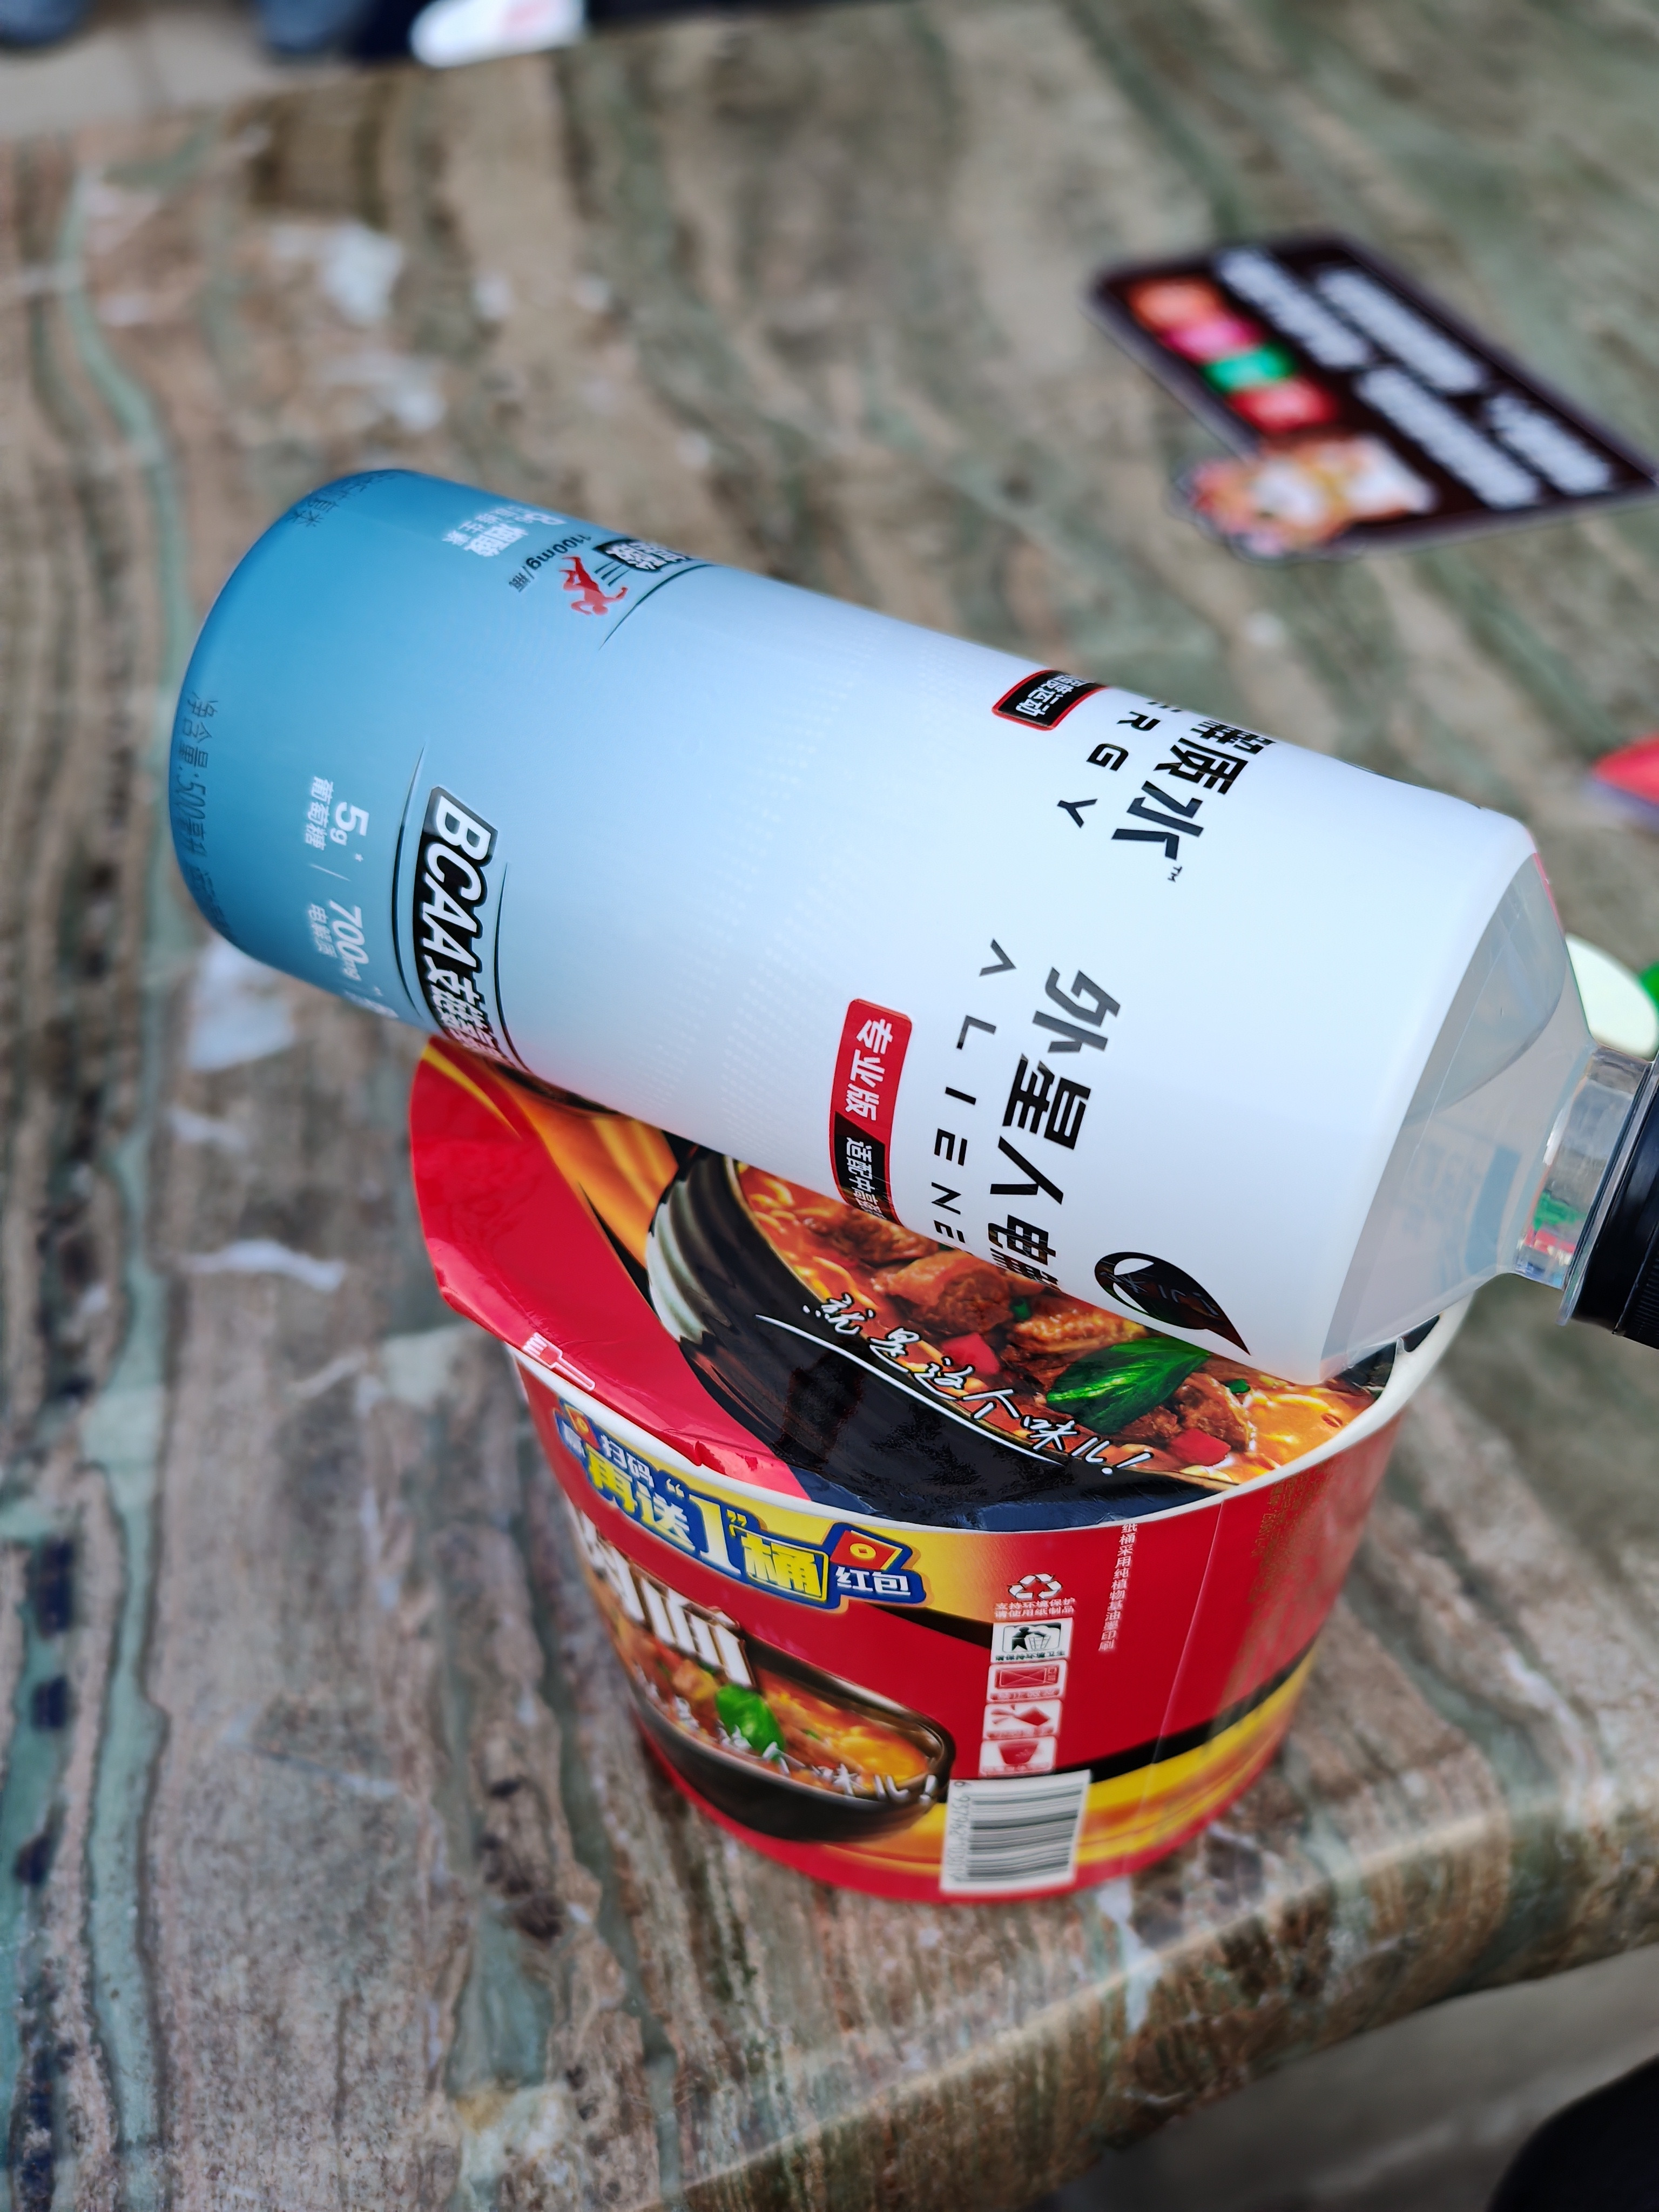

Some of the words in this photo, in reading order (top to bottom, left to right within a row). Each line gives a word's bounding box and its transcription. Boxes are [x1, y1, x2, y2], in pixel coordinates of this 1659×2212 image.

[503, 534, 592, 593] 1100mg/瓶
[304, 776, 333, 851] 葡萄糖
[845, 1017, 893, 1122] 专业版
[601, 1434, 655, 1489] 扫码
[835, 1566, 911, 1597] 红包
[995, 1597, 1076, 1610] 支持环境保护
